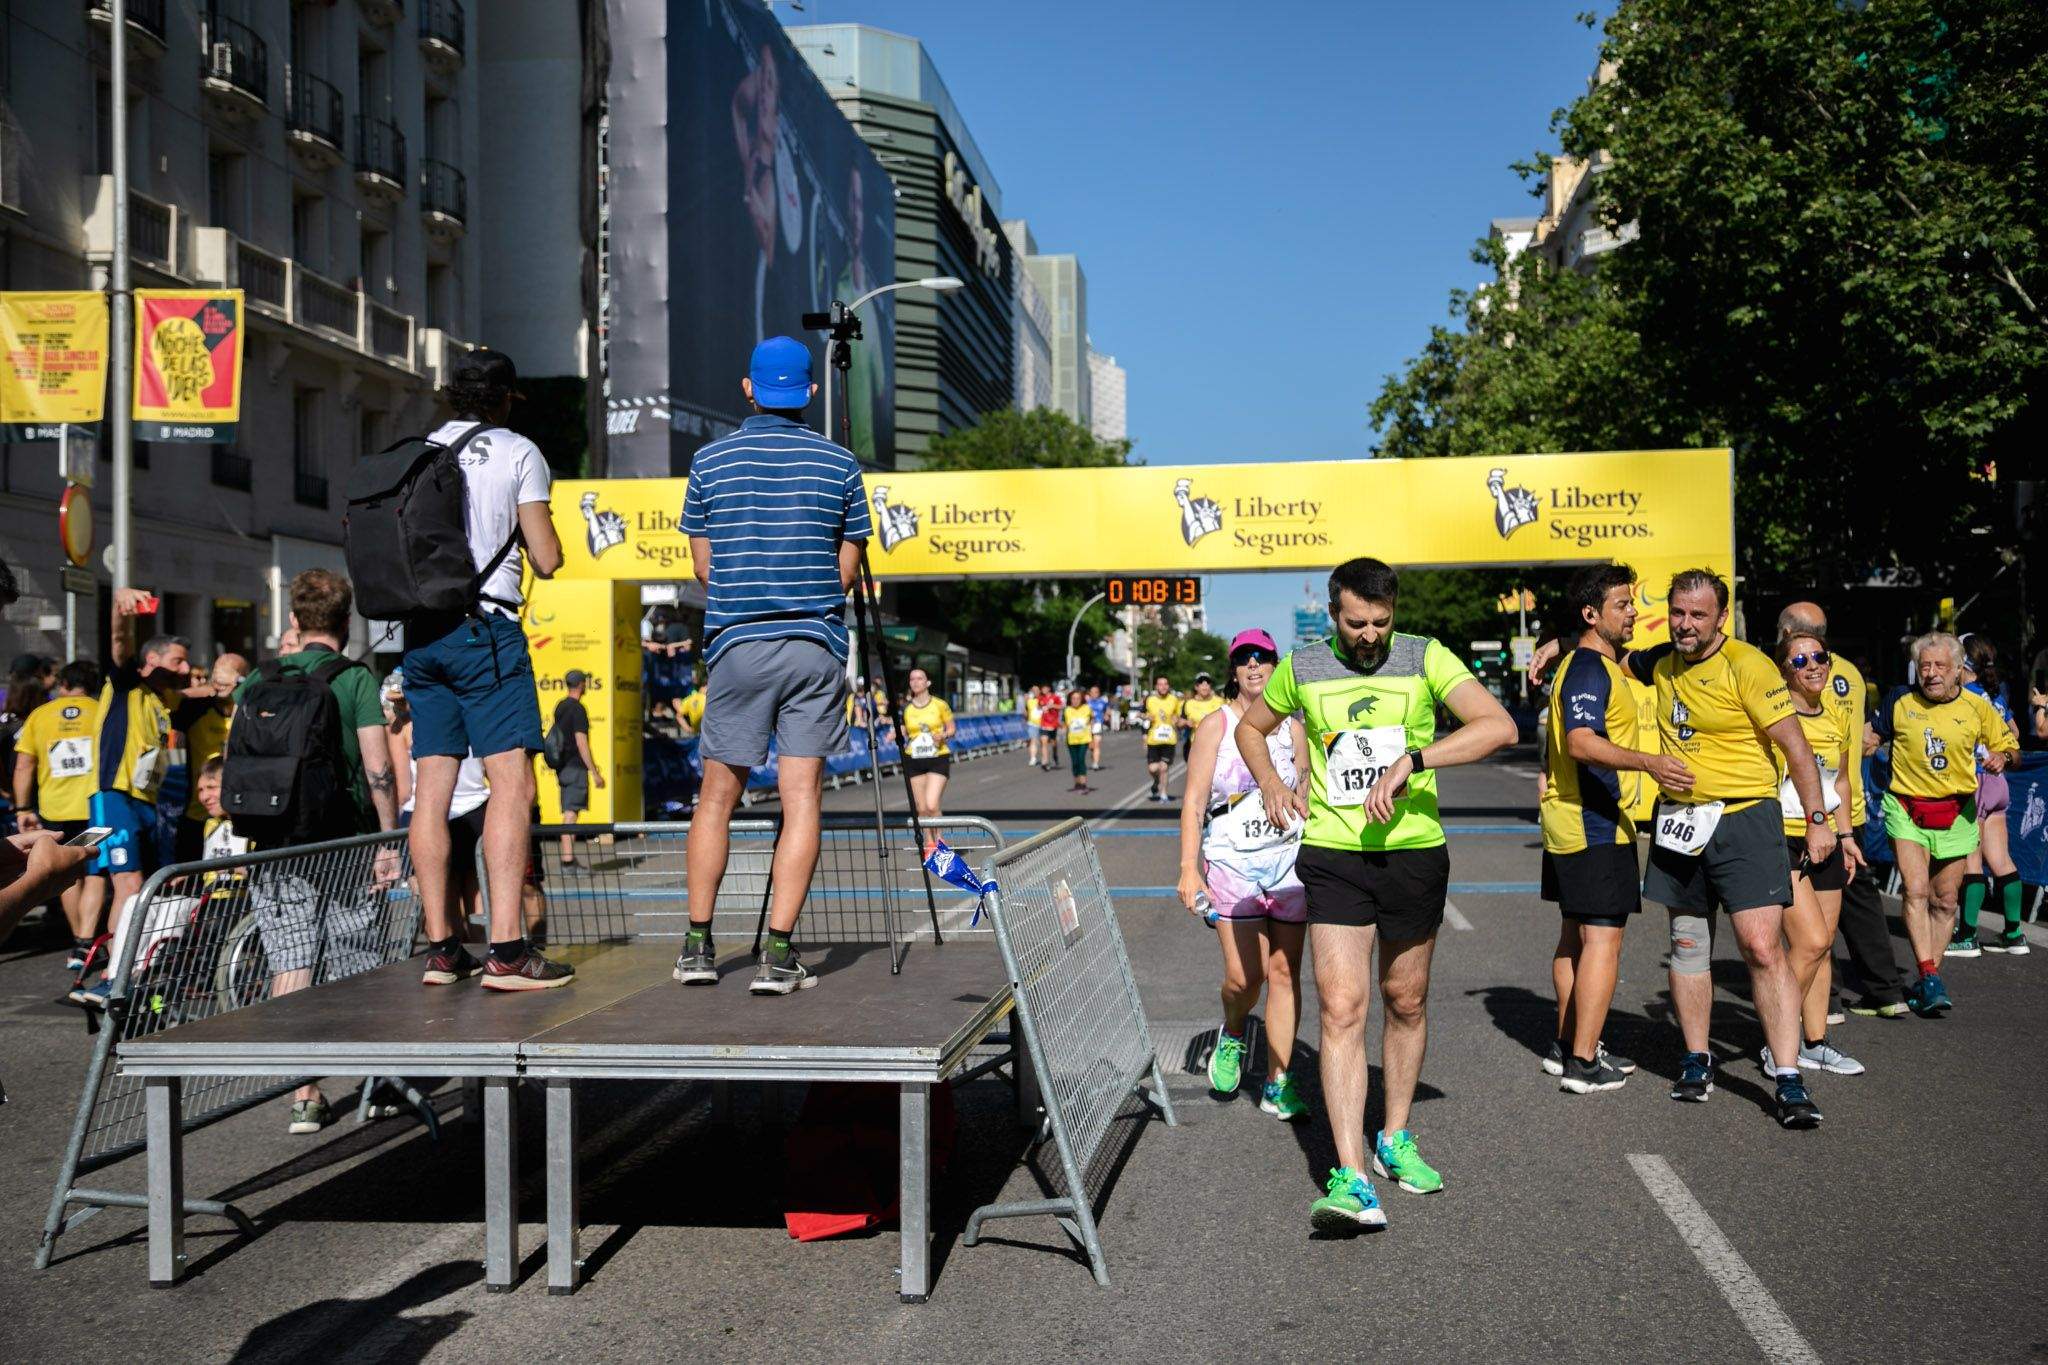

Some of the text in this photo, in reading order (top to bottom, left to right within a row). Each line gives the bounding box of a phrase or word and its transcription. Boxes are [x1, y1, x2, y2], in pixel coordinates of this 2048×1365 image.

[173, 427, 214, 438] MADRID
[1235, 496, 1322, 524] Liberty
[1551, 486, 1642, 515] Liberty
[931, 503, 1015, 531] Liberty
[1835, 679, 1847, 692] 13
[1933, 757, 1946, 768] 13
[1661, 818, 1696, 842] 846
